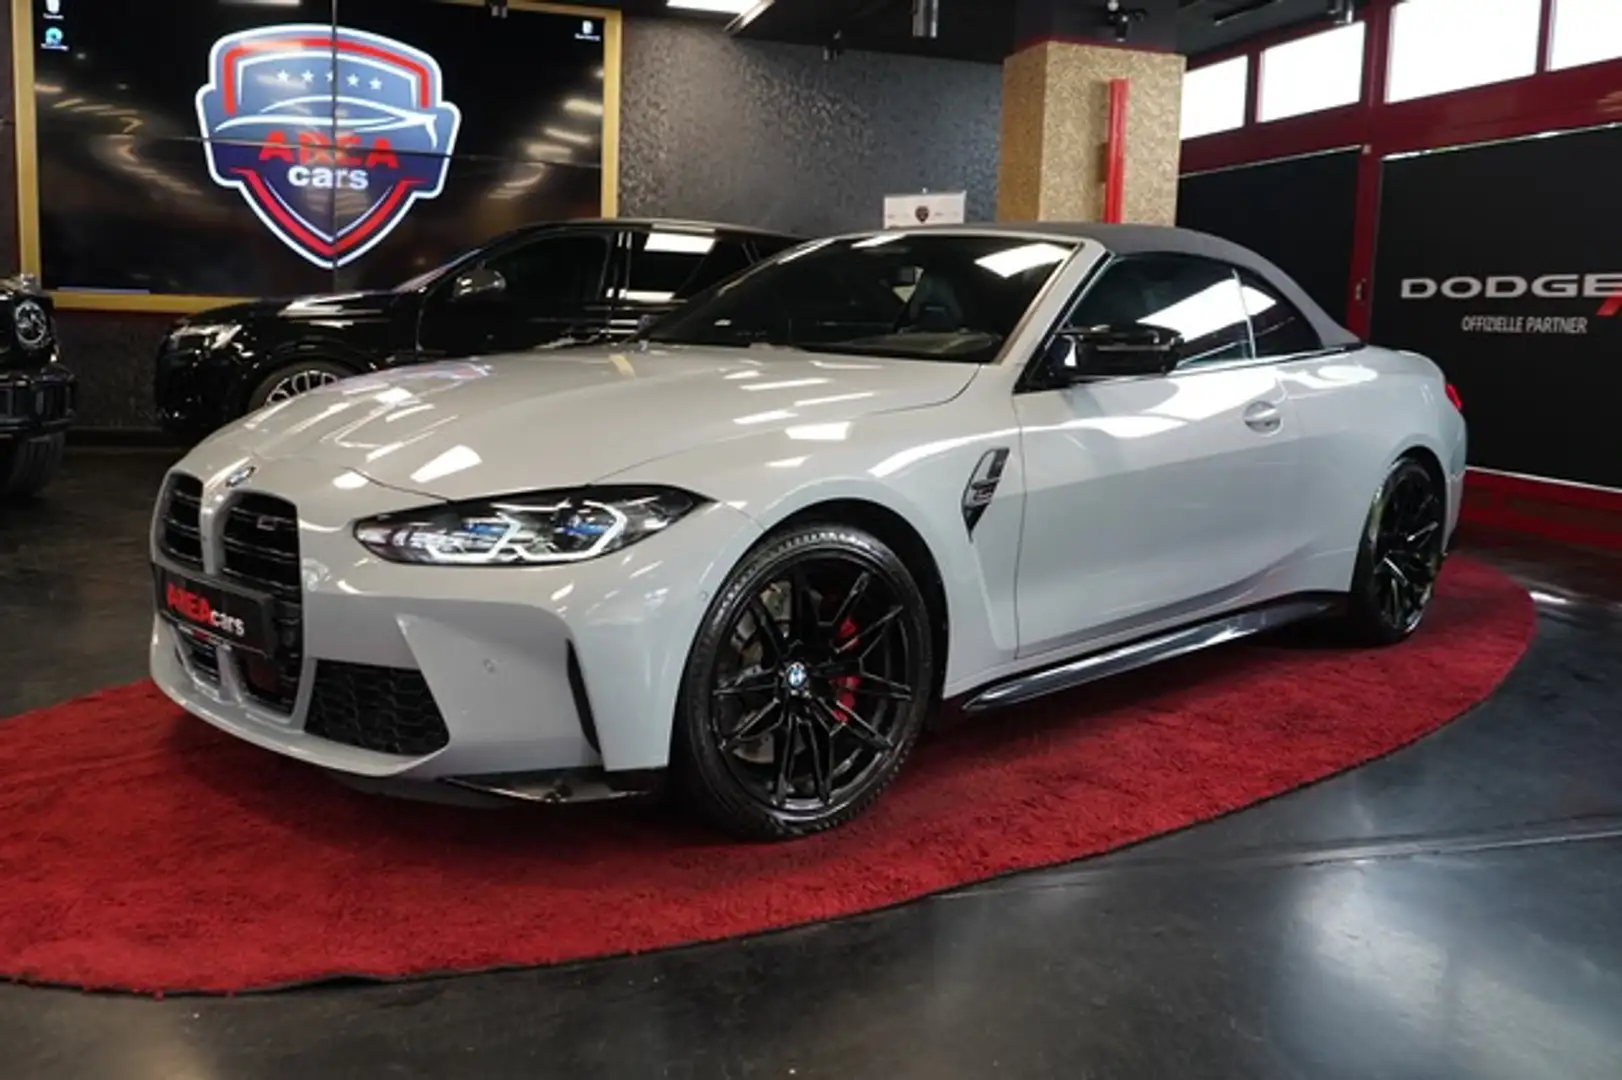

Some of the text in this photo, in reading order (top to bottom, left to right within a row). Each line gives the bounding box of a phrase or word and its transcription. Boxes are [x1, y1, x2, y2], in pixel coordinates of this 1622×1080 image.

[258, 130, 399, 169] AREA
[287, 165, 369, 190] cars
[1401, 273, 1622, 299] DODGE
[1461, 315, 1588, 334] OFFIZIELLE PARTNER
